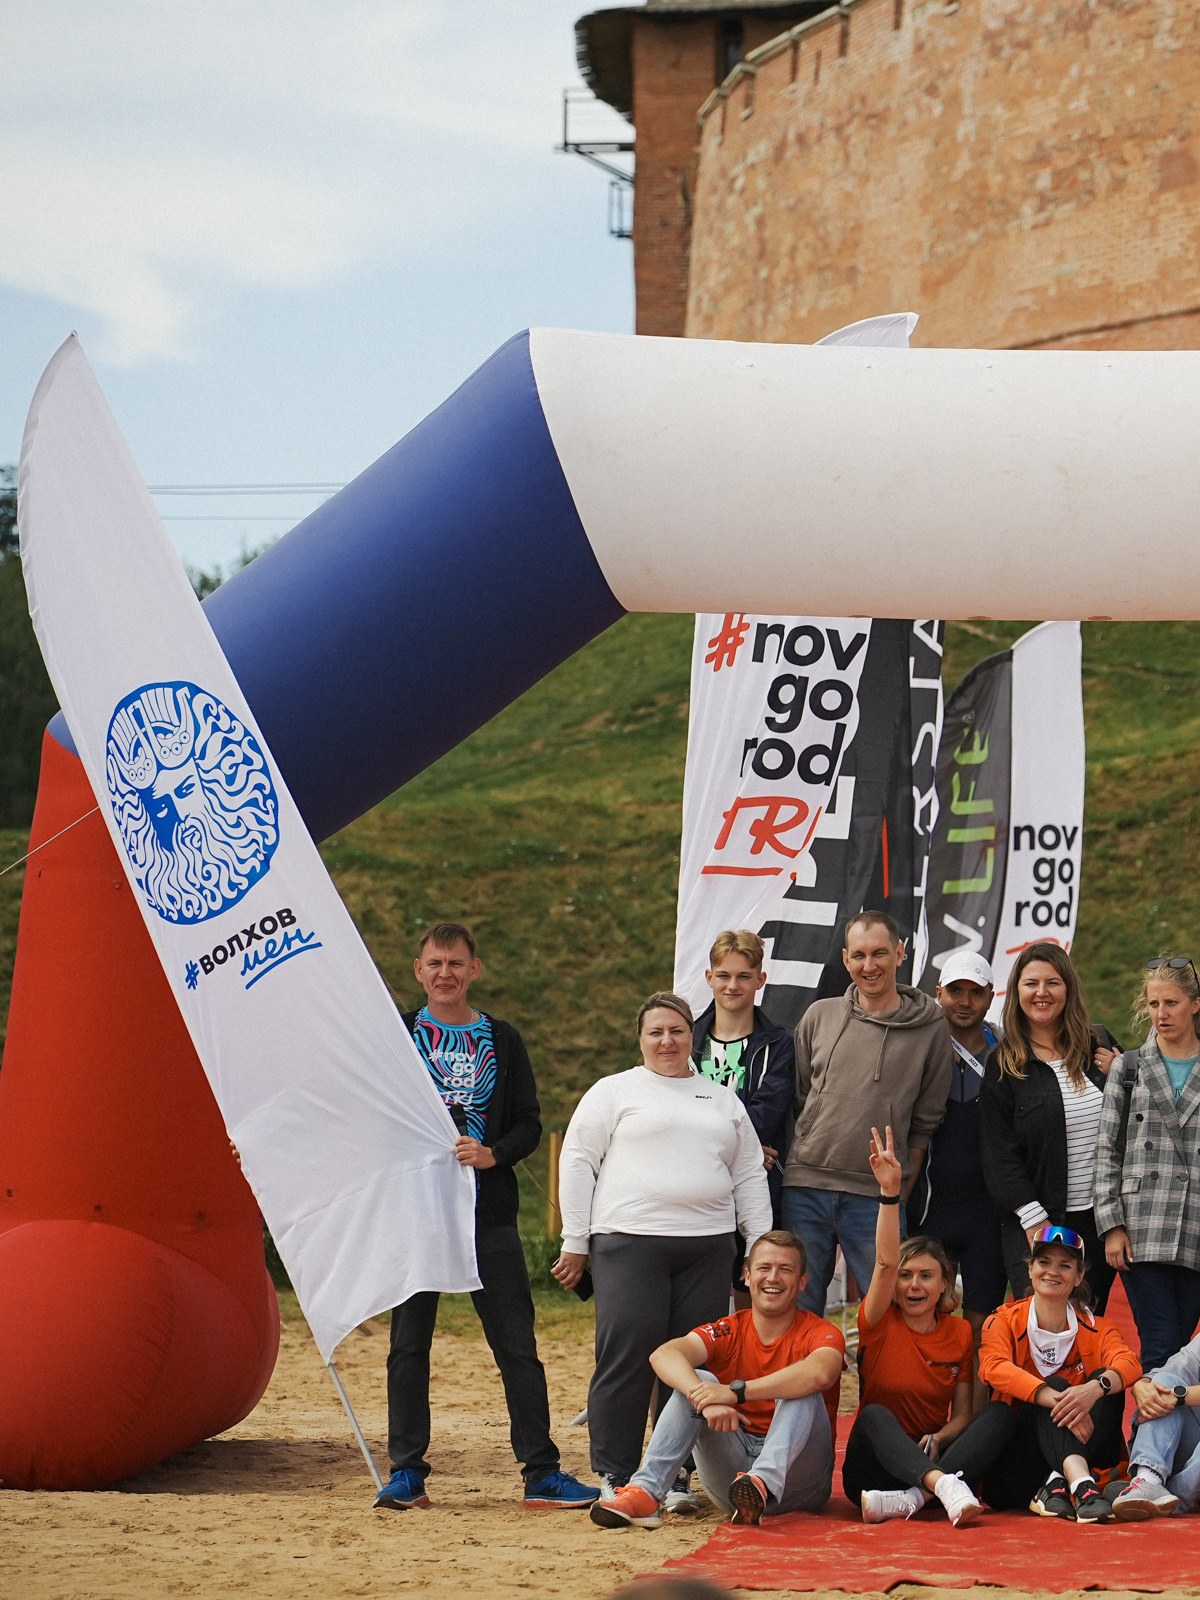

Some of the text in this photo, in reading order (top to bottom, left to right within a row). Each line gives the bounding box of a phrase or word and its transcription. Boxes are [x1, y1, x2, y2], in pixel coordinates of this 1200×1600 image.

[765, 673, 854, 734] go
[739, 722, 847, 787] rod
[1033, 857, 1074, 896] go
[1014, 886, 1074, 927] rod
[240, 928, 315, 977] мен
[428, 1049, 476, 1062] #nov
[452, 1062, 476, 1077] go
[443, 1073, 476, 1088] rod
